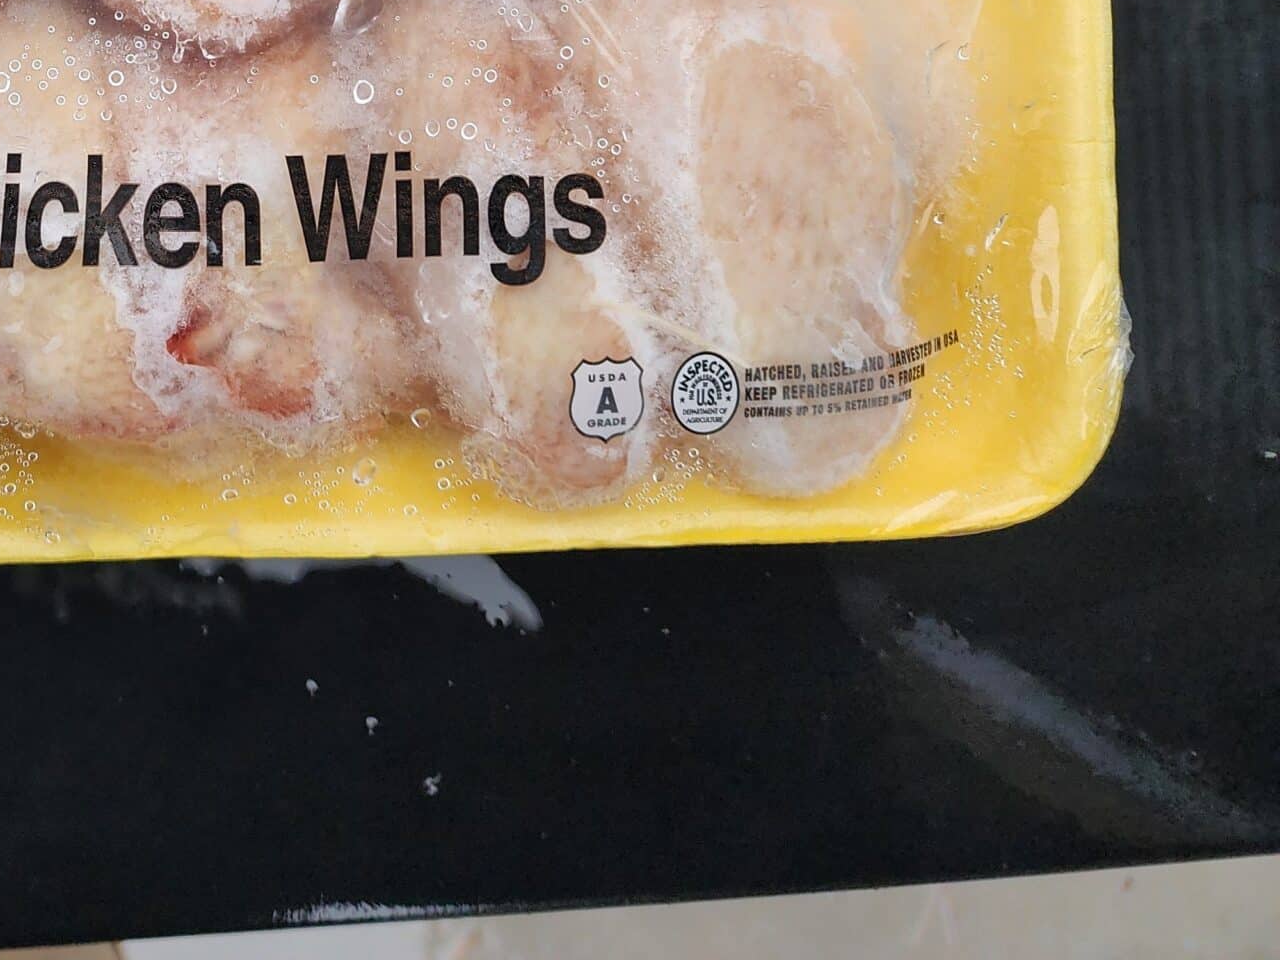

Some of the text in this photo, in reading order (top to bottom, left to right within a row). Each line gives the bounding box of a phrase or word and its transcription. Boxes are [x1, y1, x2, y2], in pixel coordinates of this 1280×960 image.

[285, 151, 608, 287] Wings
[588, 373, 626, 383] USDA
[678, 359, 733, 392] INSPECTED
[745, 364, 807, 383] HATCHED,
[861, 355, 884, 373] AND
[745, 387, 777, 401] KEEP
[782, 378, 874, 401] REFRIGERATED
[880, 374, 895, 390] OR
[898, 364, 925, 387] FROZEN
[596, 387, 618, 414] A
[697, 388, 717, 406] U.S.
[744, 404, 792, 418] CONTAINS
[796, 404, 809, 416] UP
[812, 403, 824, 415] TO
[827, 402, 841, 414] 5%
[845, 395, 889, 411] RETAINED
[587, 417, 626, 428] GRADE
